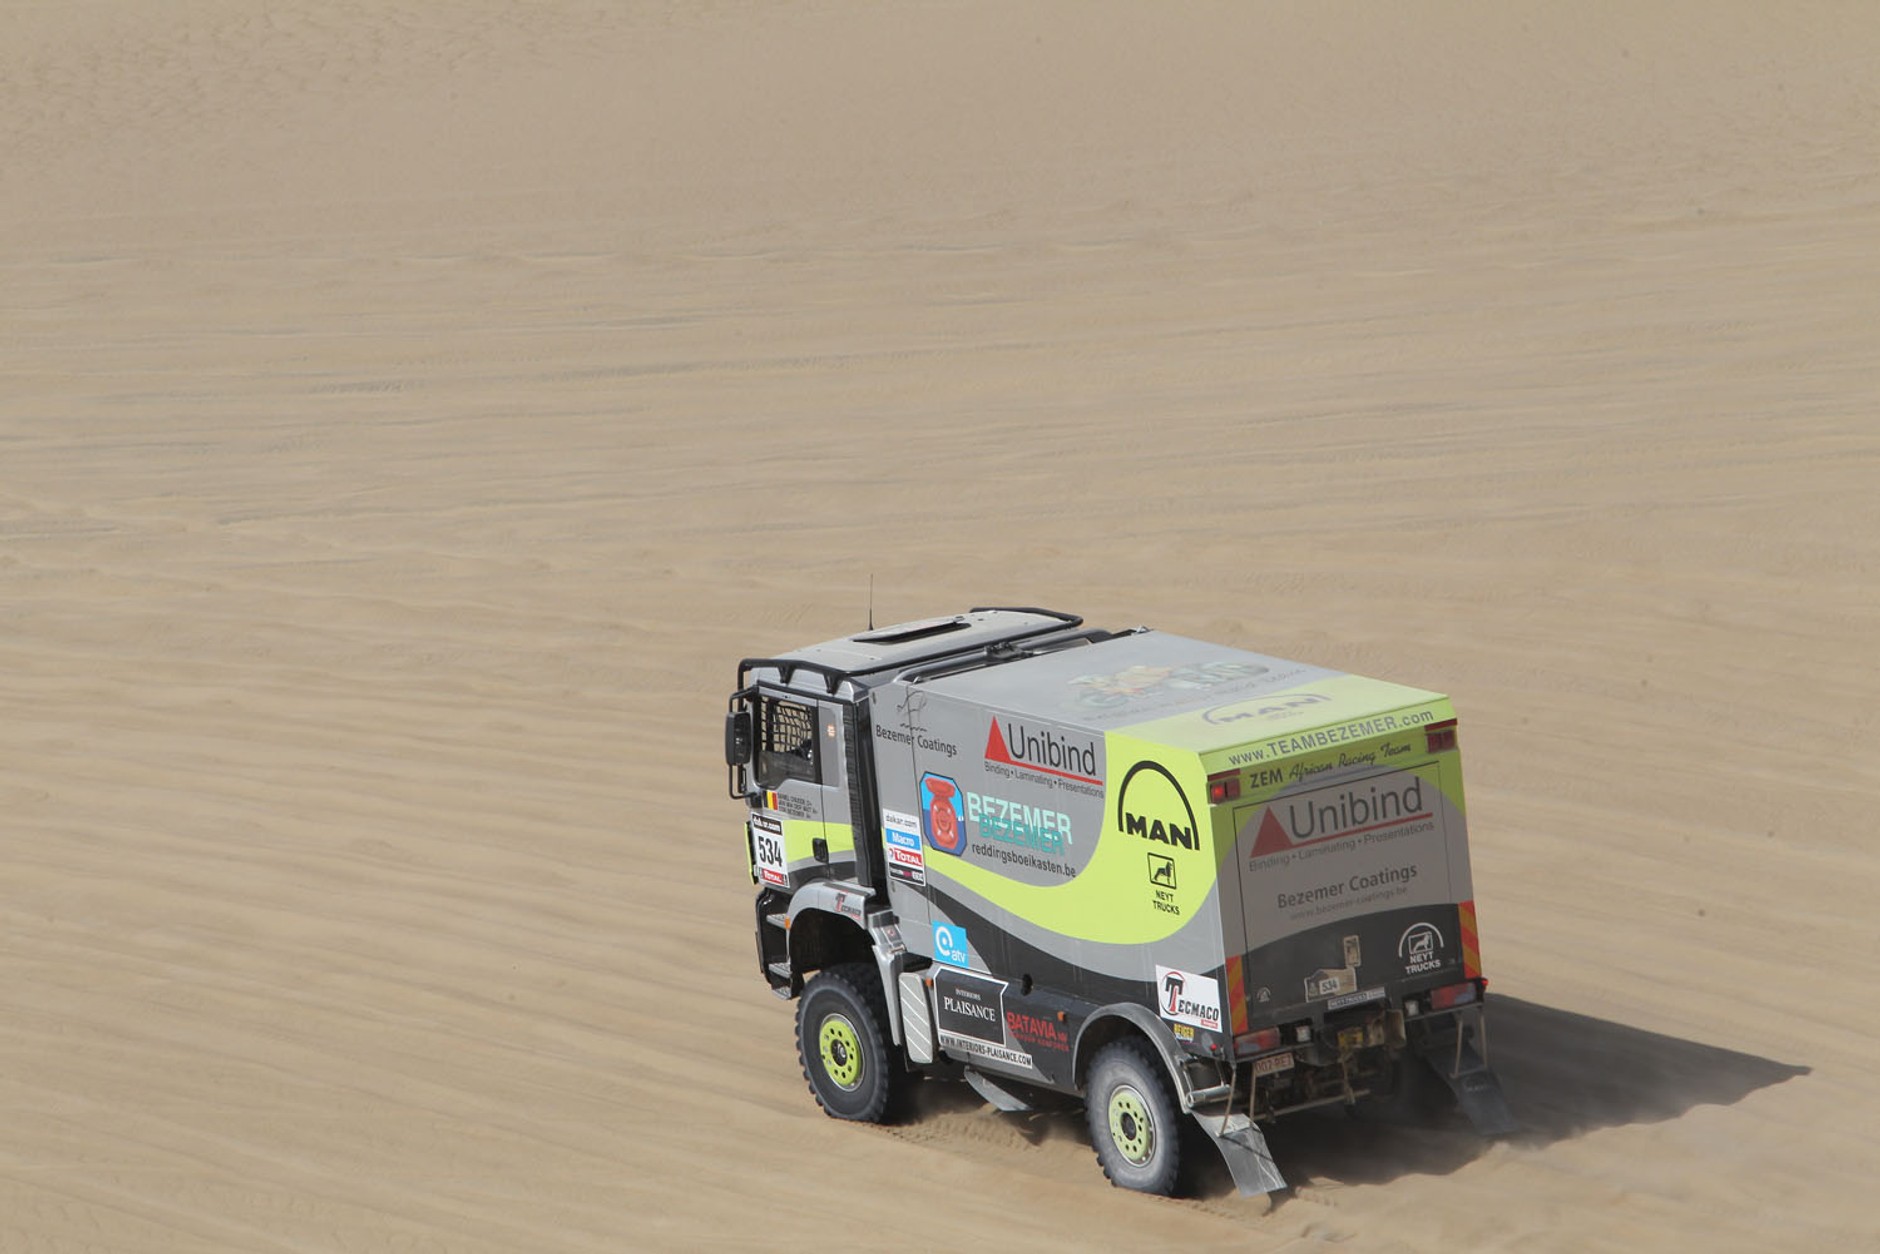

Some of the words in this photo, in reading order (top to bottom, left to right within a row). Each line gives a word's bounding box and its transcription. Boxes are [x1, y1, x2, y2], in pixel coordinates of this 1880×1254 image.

[1218, 696, 1322, 722] MAN
[876, 724, 915, 748] Bezemer
[917, 735, 958, 757] Coatings
[1008, 723, 1096, 776] Unibind
[1229, 710, 1434, 766] www.TEAMBEZEMER.com
[984, 761, 1010, 779] Binding
[1015, 770, 1053, 789] Laminating
[1058, 780, 1104, 799] Presentations
[1250, 769, 1283, 789] ZEM
[1289, 761, 1333, 781] African
[1338, 753, 1376, 768] Racing
[1380, 743, 1411, 758] Team
[967, 792, 1073, 845] BEZEMER
[1290, 776, 1423, 838] Unibind
[979, 813, 1065, 857] BEZEMER
[1125, 812, 1193, 850] MAN
[1249, 854, 1290, 872] Binding
[1299, 838, 1356, 860] Laminating
[1363, 820, 1434, 845] Presentations
[758, 835, 783, 868] 534
[896, 851, 922, 866] TOTAL
[972, 844, 1077, 878] reddingsboeikasten.be
[1155, 889, 1174, 902] NEYT
[1277, 881, 1345, 909] Bezemer
[1350, 864, 1418, 892] Coatings
[1152, 900, 1180, 916] TRUCKS
[951, 950, 966, 963] atv
[1405, 960, 1441, 974] TRUCKS
[1410, 952, 1434, 964] NEYT
[1165, 976, 1219, 1021] TECMACO
[1321, 978, 1338, 992] 534
[944, 996, 996, 1022] PLAISANCE
[1006, 1011, 1057, 1040] BATAVIA
[940, 1035, 1032, 1066] WWW.INTERIORS-PLAISANCE.COM
